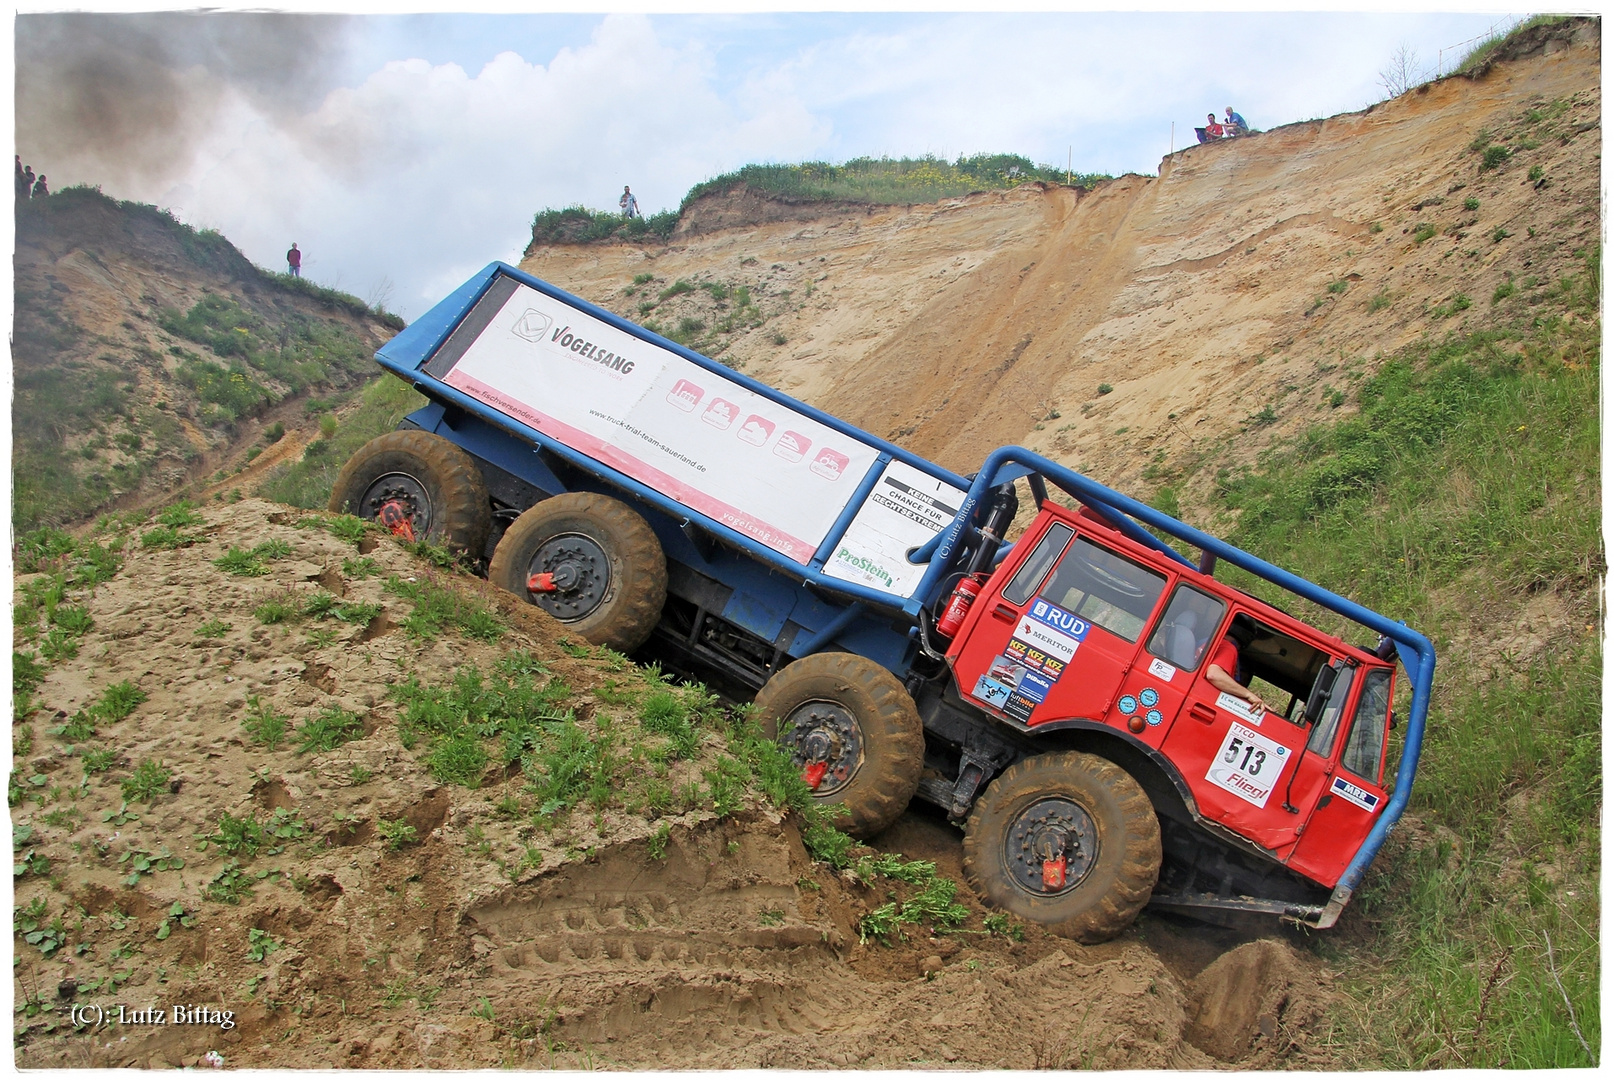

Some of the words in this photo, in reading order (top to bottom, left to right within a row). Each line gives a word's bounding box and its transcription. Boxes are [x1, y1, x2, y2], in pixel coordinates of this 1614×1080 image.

[551, 326, 635, 375] VOGELSANG
[466, 384, 541, 425] www.fischversender.de
[589, 408, 707, 474] www.truck-trial-team-sauerland.de
[889, 490, 924, 512] CHANCE
[908, 488, 935, 506] KEINE
[723, 512, 793, 552] vogelsang.info
[837, 547, 890, 581] ProStein
[1047, 607, 1085, 635] RUD
[1009, 640, 1028, 653] KFZ
[1027, 648, 1046, 663] KFZ
[1045, 657, 1064, 671] KFZ
[1033, 630, 1074, 656] MERITOR
[1234, 724, 1256, 739] TTCD
[1224, 737, 1267, 776] 513
[1226, 772, 1269, 800] Fliegl
[1344, 783, 1368, 801] MRR
